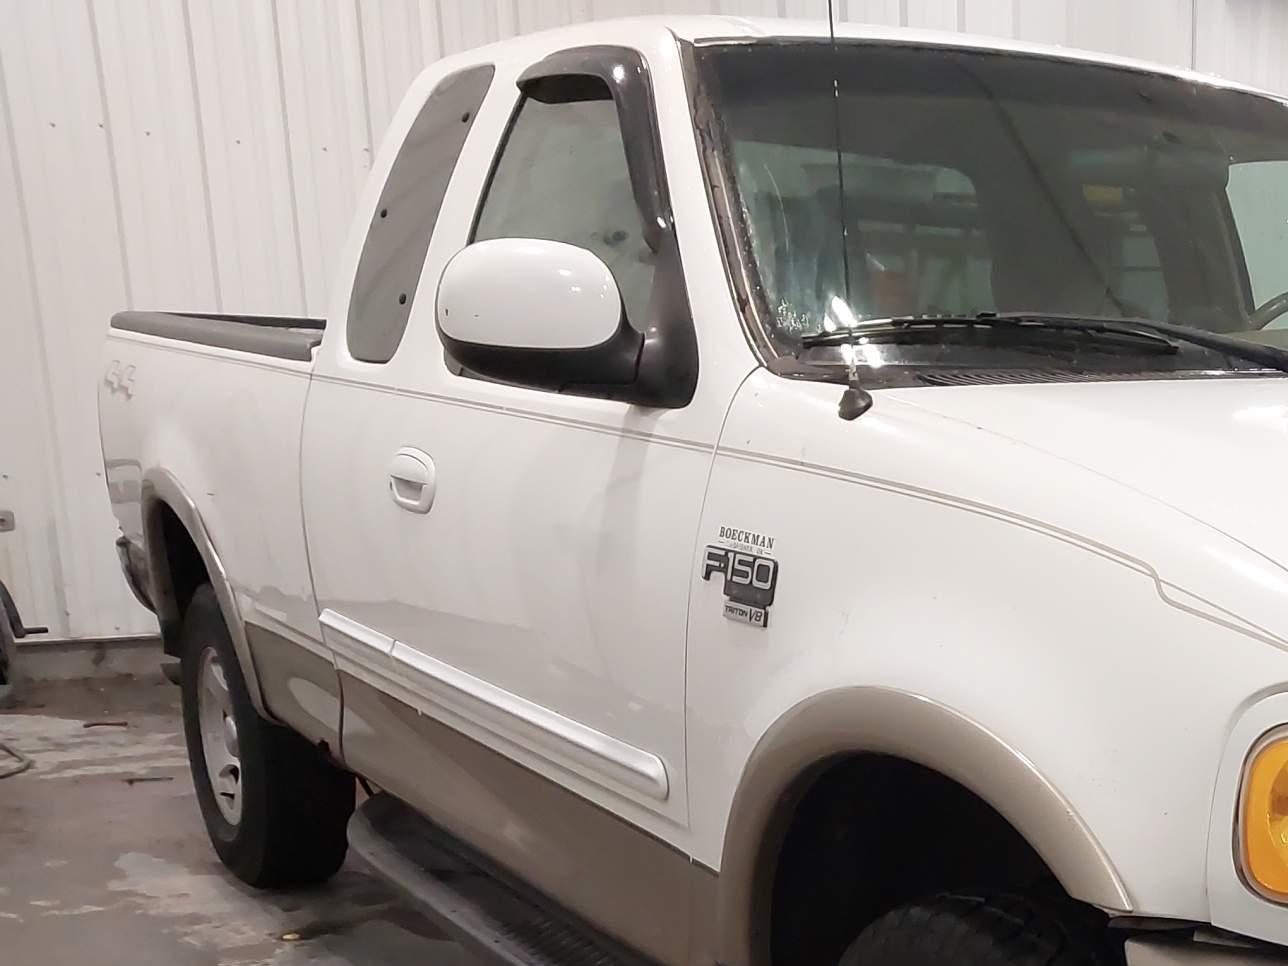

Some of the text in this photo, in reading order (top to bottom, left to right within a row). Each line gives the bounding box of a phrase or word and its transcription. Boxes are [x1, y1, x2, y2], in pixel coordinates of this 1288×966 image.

[719, 525, 775, 550] BOECKMAN
[724, 604, 763, 623] TRITON V8
